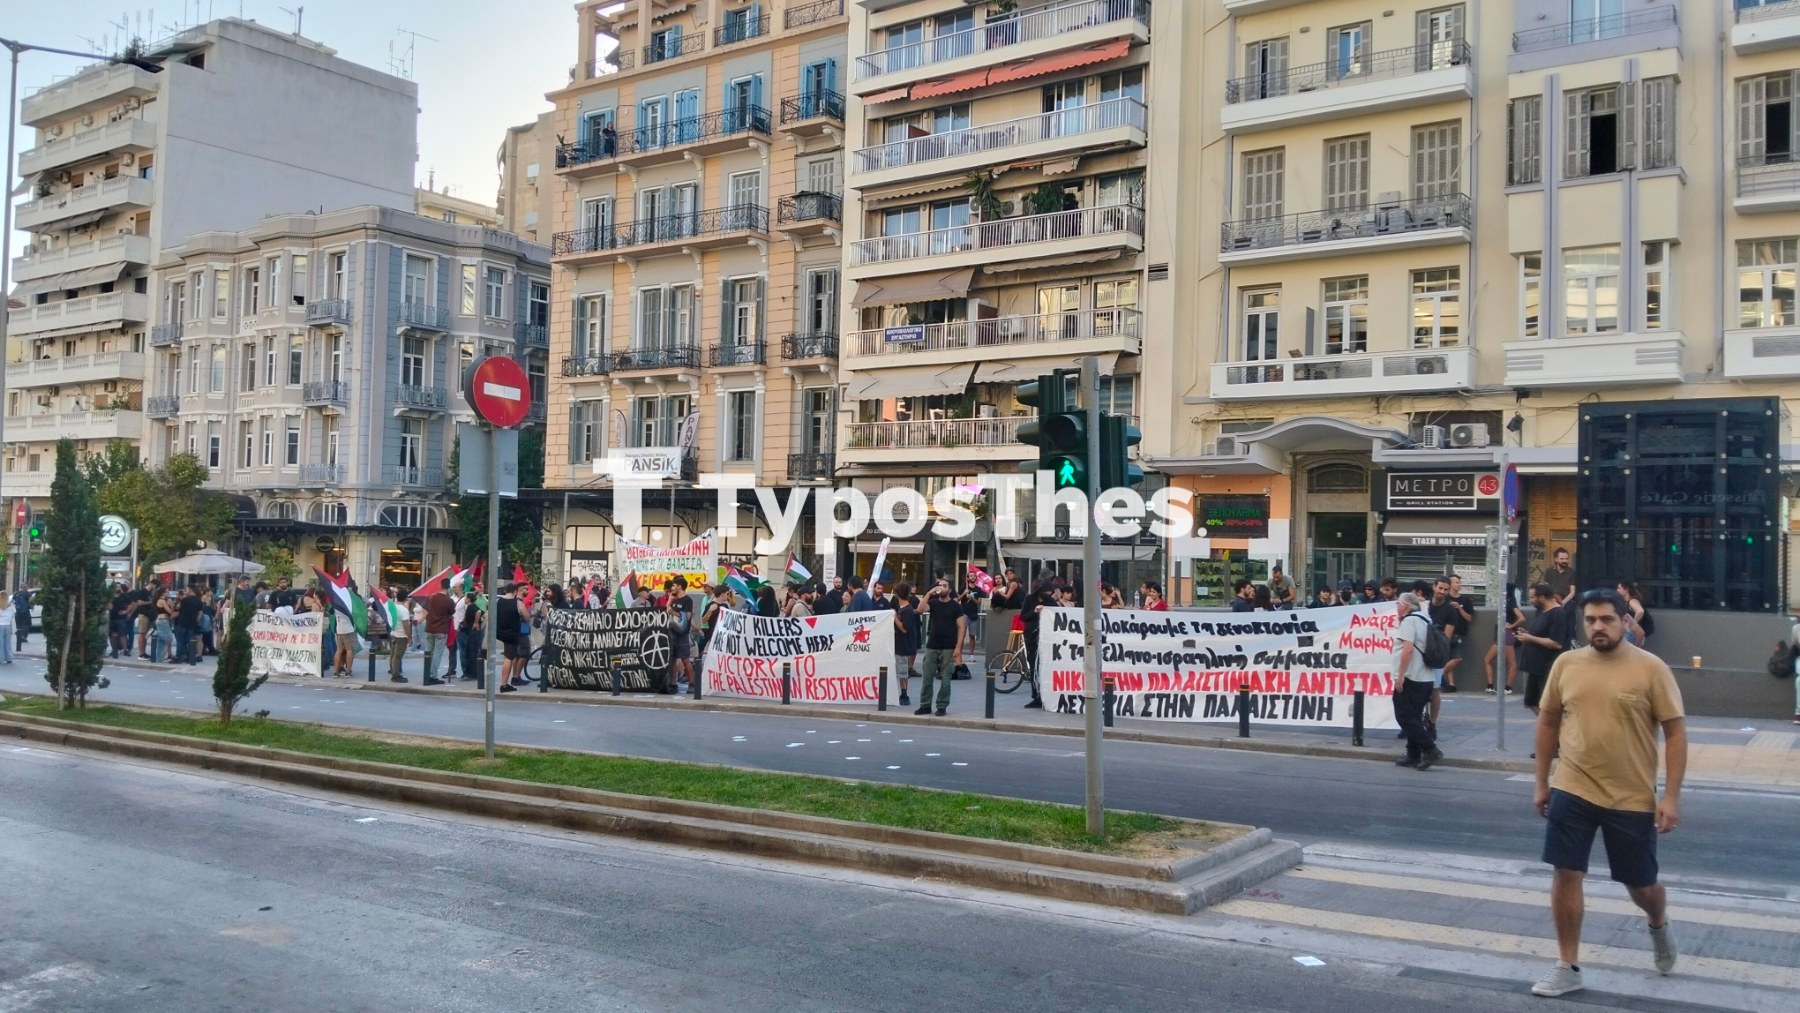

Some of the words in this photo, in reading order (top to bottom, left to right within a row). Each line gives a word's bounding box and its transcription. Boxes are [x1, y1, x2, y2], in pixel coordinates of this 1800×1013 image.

[1412, 537, 1436, 545] ΣΤΑΣΗ
[1438, 537, 1452, 545] ΚΑΙ
[753, 617, 803, 637] KILLERS
[1053, 612, 1083, 634] Να
[1190, 621, 1216, 637] τη
[1216, 614, 1320, 637] γενοκτονία
[725, 633, 741, 656] NOT
[744, 636, 804, 657] WELCOME
[805, 634, 834, 653] HERE
[1253, 642, 1349, 670] συμμαχία
[717, 654, 778, 677] VICTORY
[794, 655, 816, 678] TO
[708, 669, 726, 692] THE
[726, 676, 803, 700] PALESTINN
[805, 676, 880, 701] RESISTANCE
[1141, 694, 1195, 719] ΣΤΗΝ
